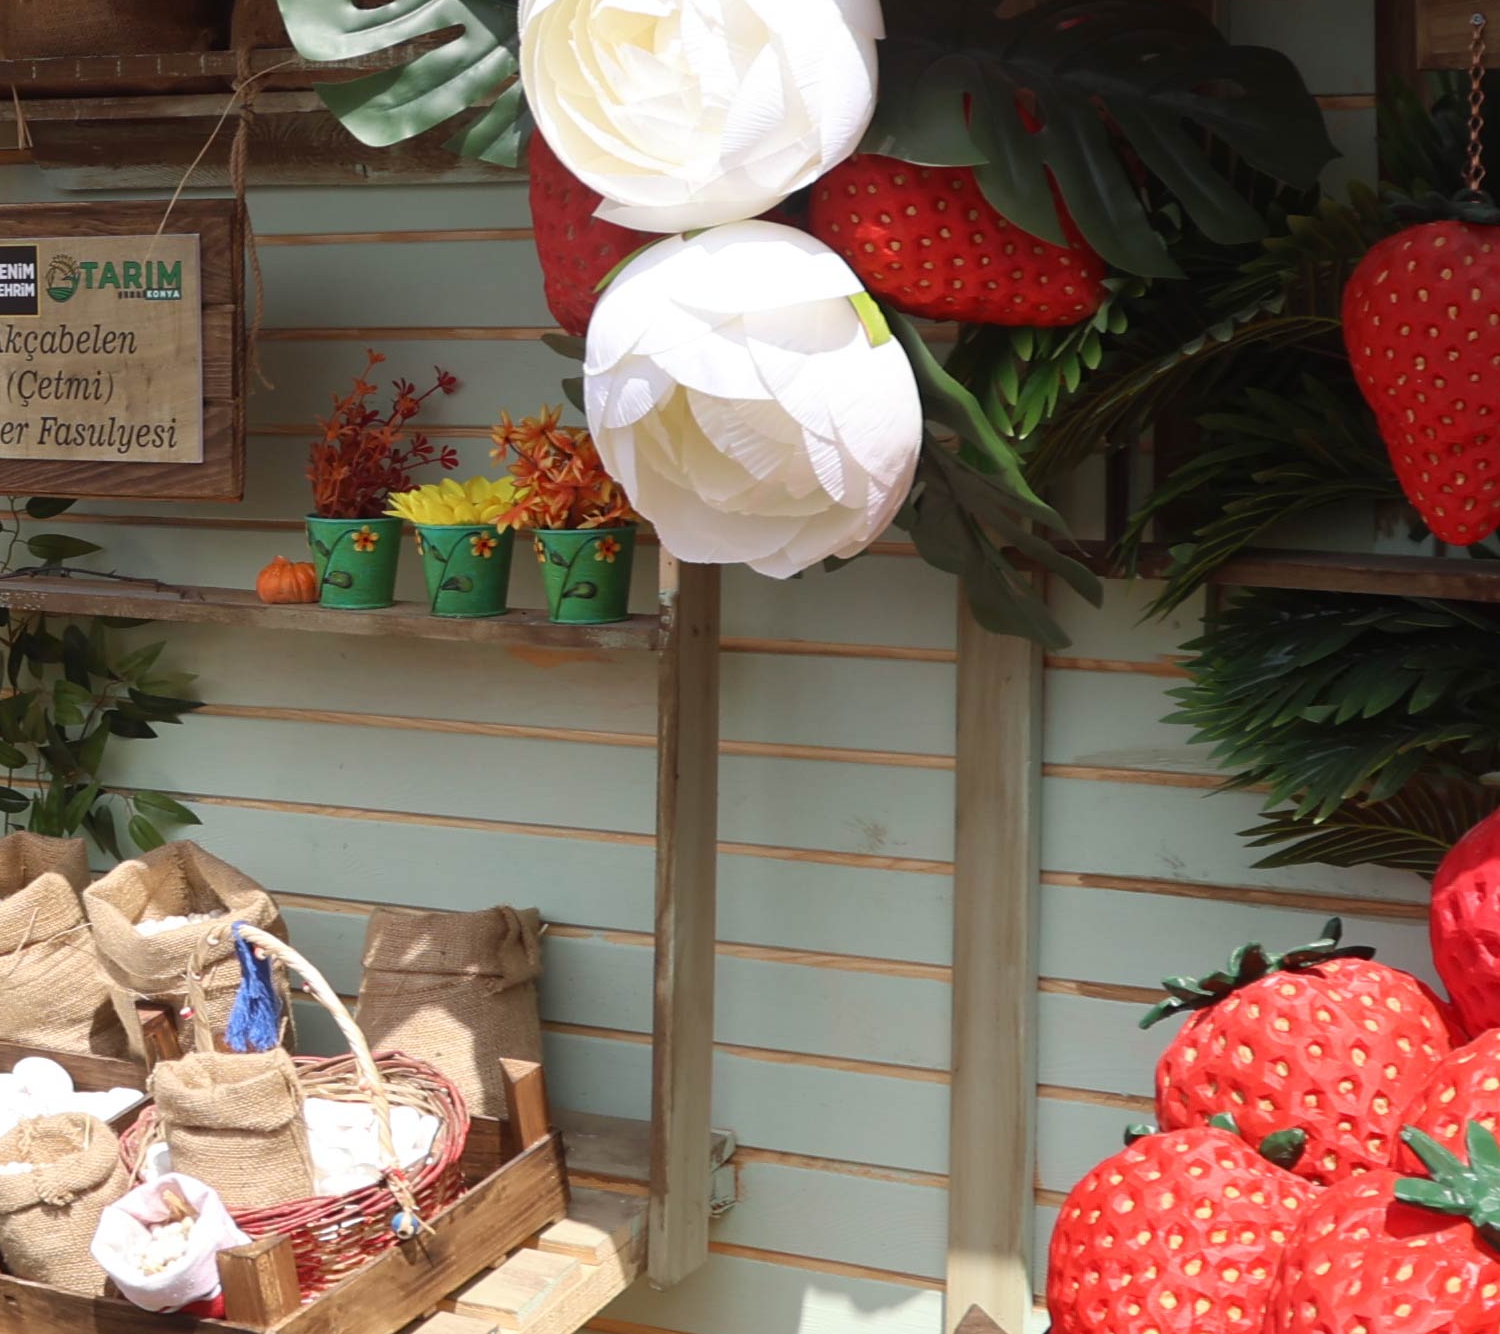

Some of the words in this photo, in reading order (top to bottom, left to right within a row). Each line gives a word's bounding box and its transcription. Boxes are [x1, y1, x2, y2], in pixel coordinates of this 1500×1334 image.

[80, 259, 183, 289] TARIM
[146, 290, 180, 298] KONYA
[7, 370, 115, 407] (Çetmi)
[37, 416, 178, 454] Fasulyesi
